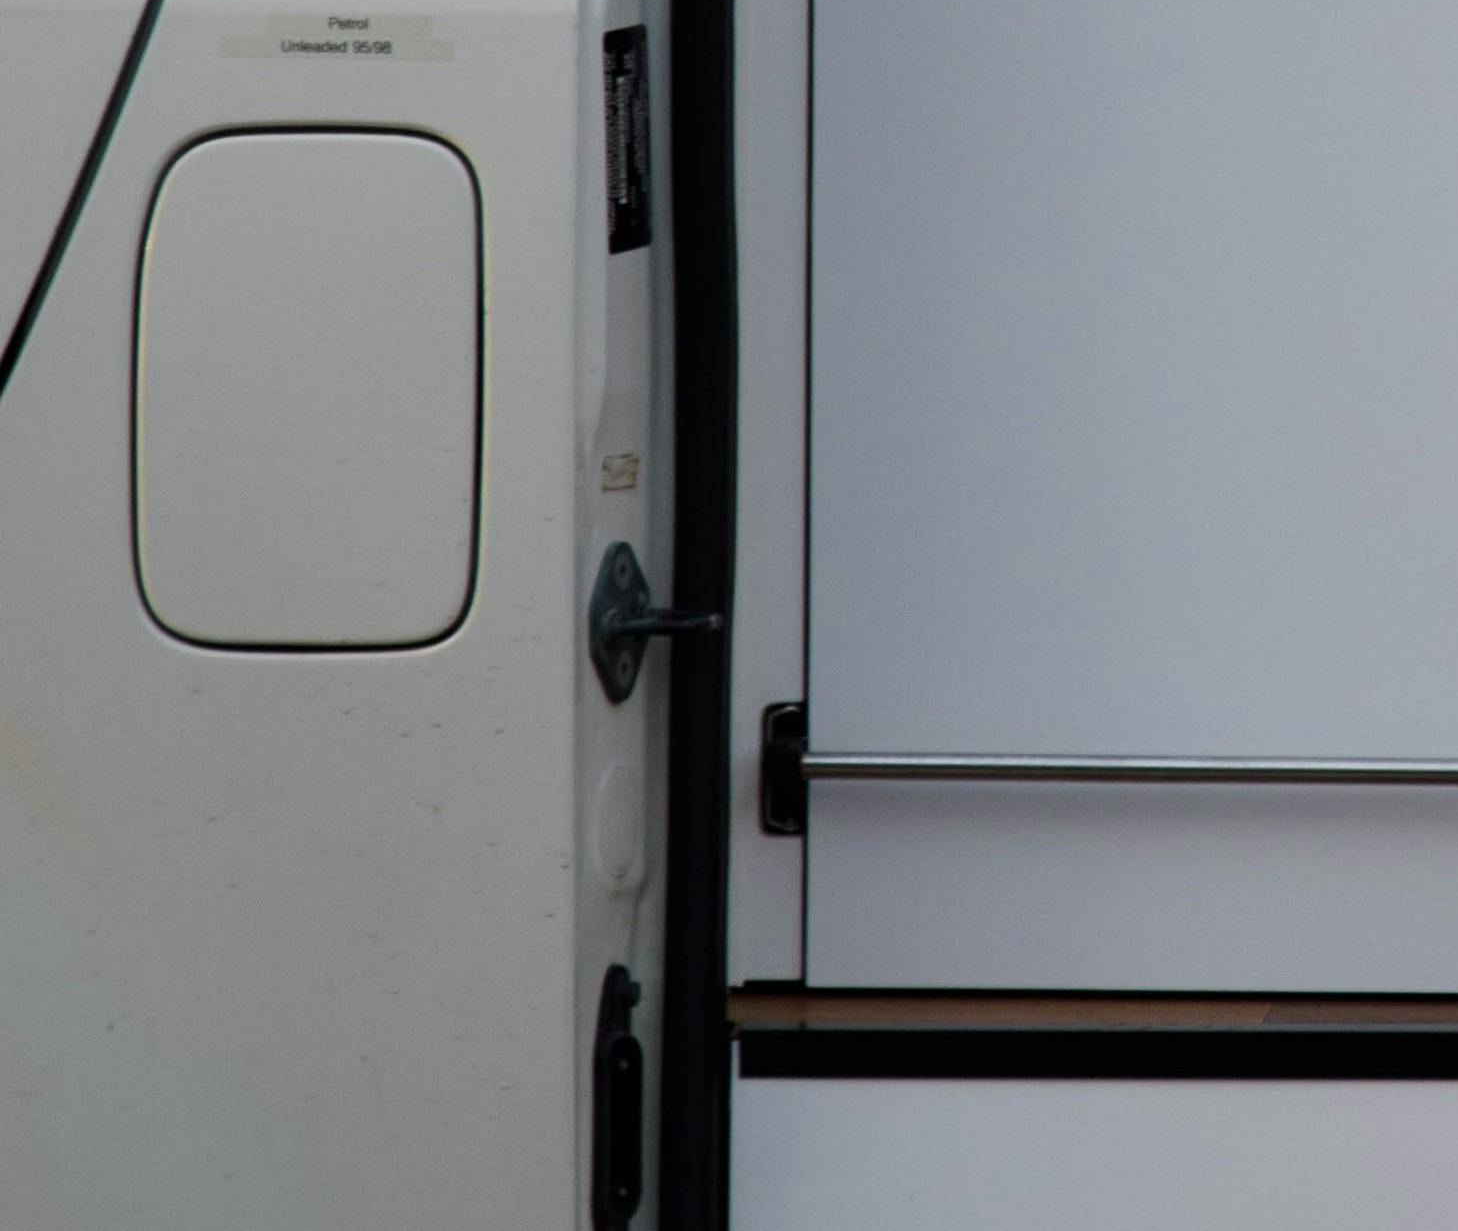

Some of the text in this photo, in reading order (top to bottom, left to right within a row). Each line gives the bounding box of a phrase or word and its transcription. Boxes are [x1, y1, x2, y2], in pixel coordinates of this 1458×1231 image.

[328, 16, 369, 30] Petrol
[281, 39, 392, 54] Unleaded 95/98
